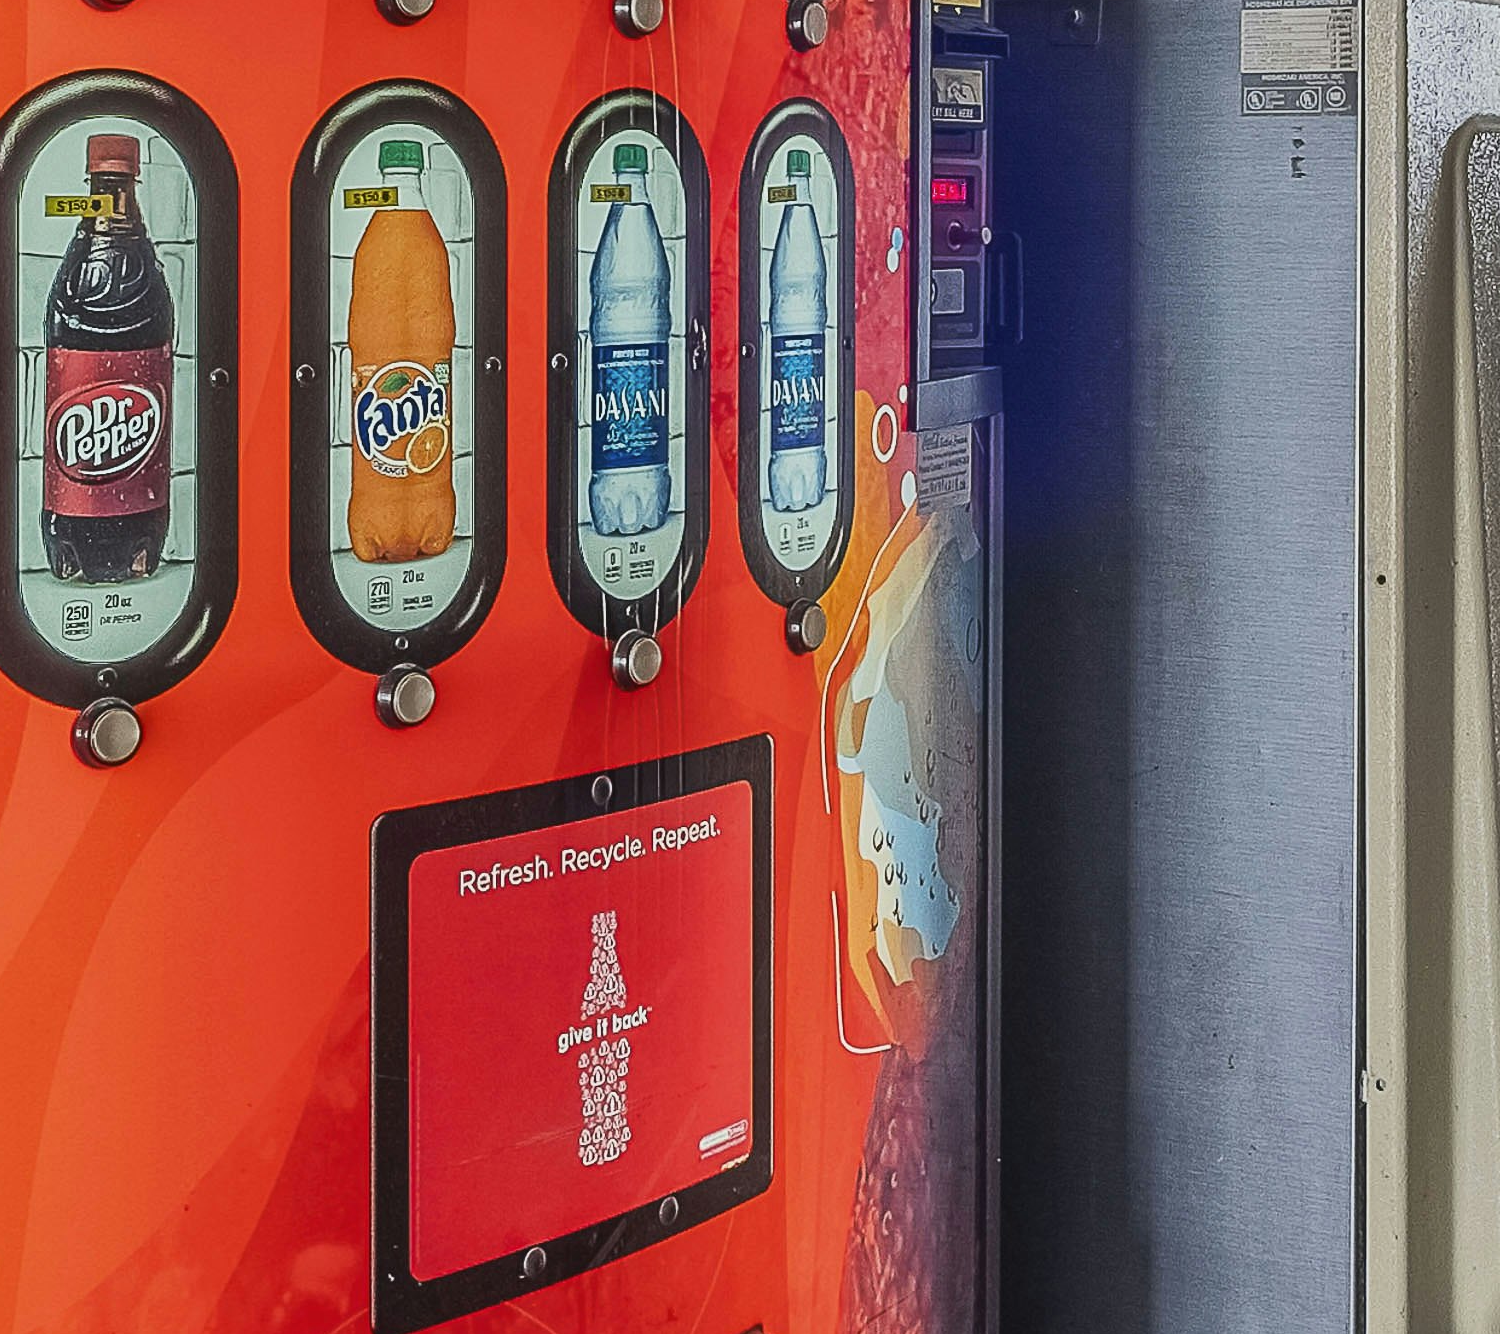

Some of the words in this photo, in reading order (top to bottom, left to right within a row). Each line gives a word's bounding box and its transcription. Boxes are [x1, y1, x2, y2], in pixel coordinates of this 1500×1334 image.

[595, 384, 665, 426] DASANI
[772, 375, 824, 409] DASANI
[92, 396, 134, 433] Dr
[356, 377, 446, 458] Fanta
[57, 405, 155, 467] Pepper
[371, 581, 390, 596] 270
[403, 569, 414, 583] 20
[66, 606, 89, 621] 250
[105, 594, 119, 608] 20
[460, 855, 554, 897] Refresh.
[561, 835, 646, 875] Recycle.
[652, 814, 721, 852] Repeat.
[558, 1026, 593, 1054] give
[597, 1018, 608, 1038] it
[612, 1005, 649, 1034] back
